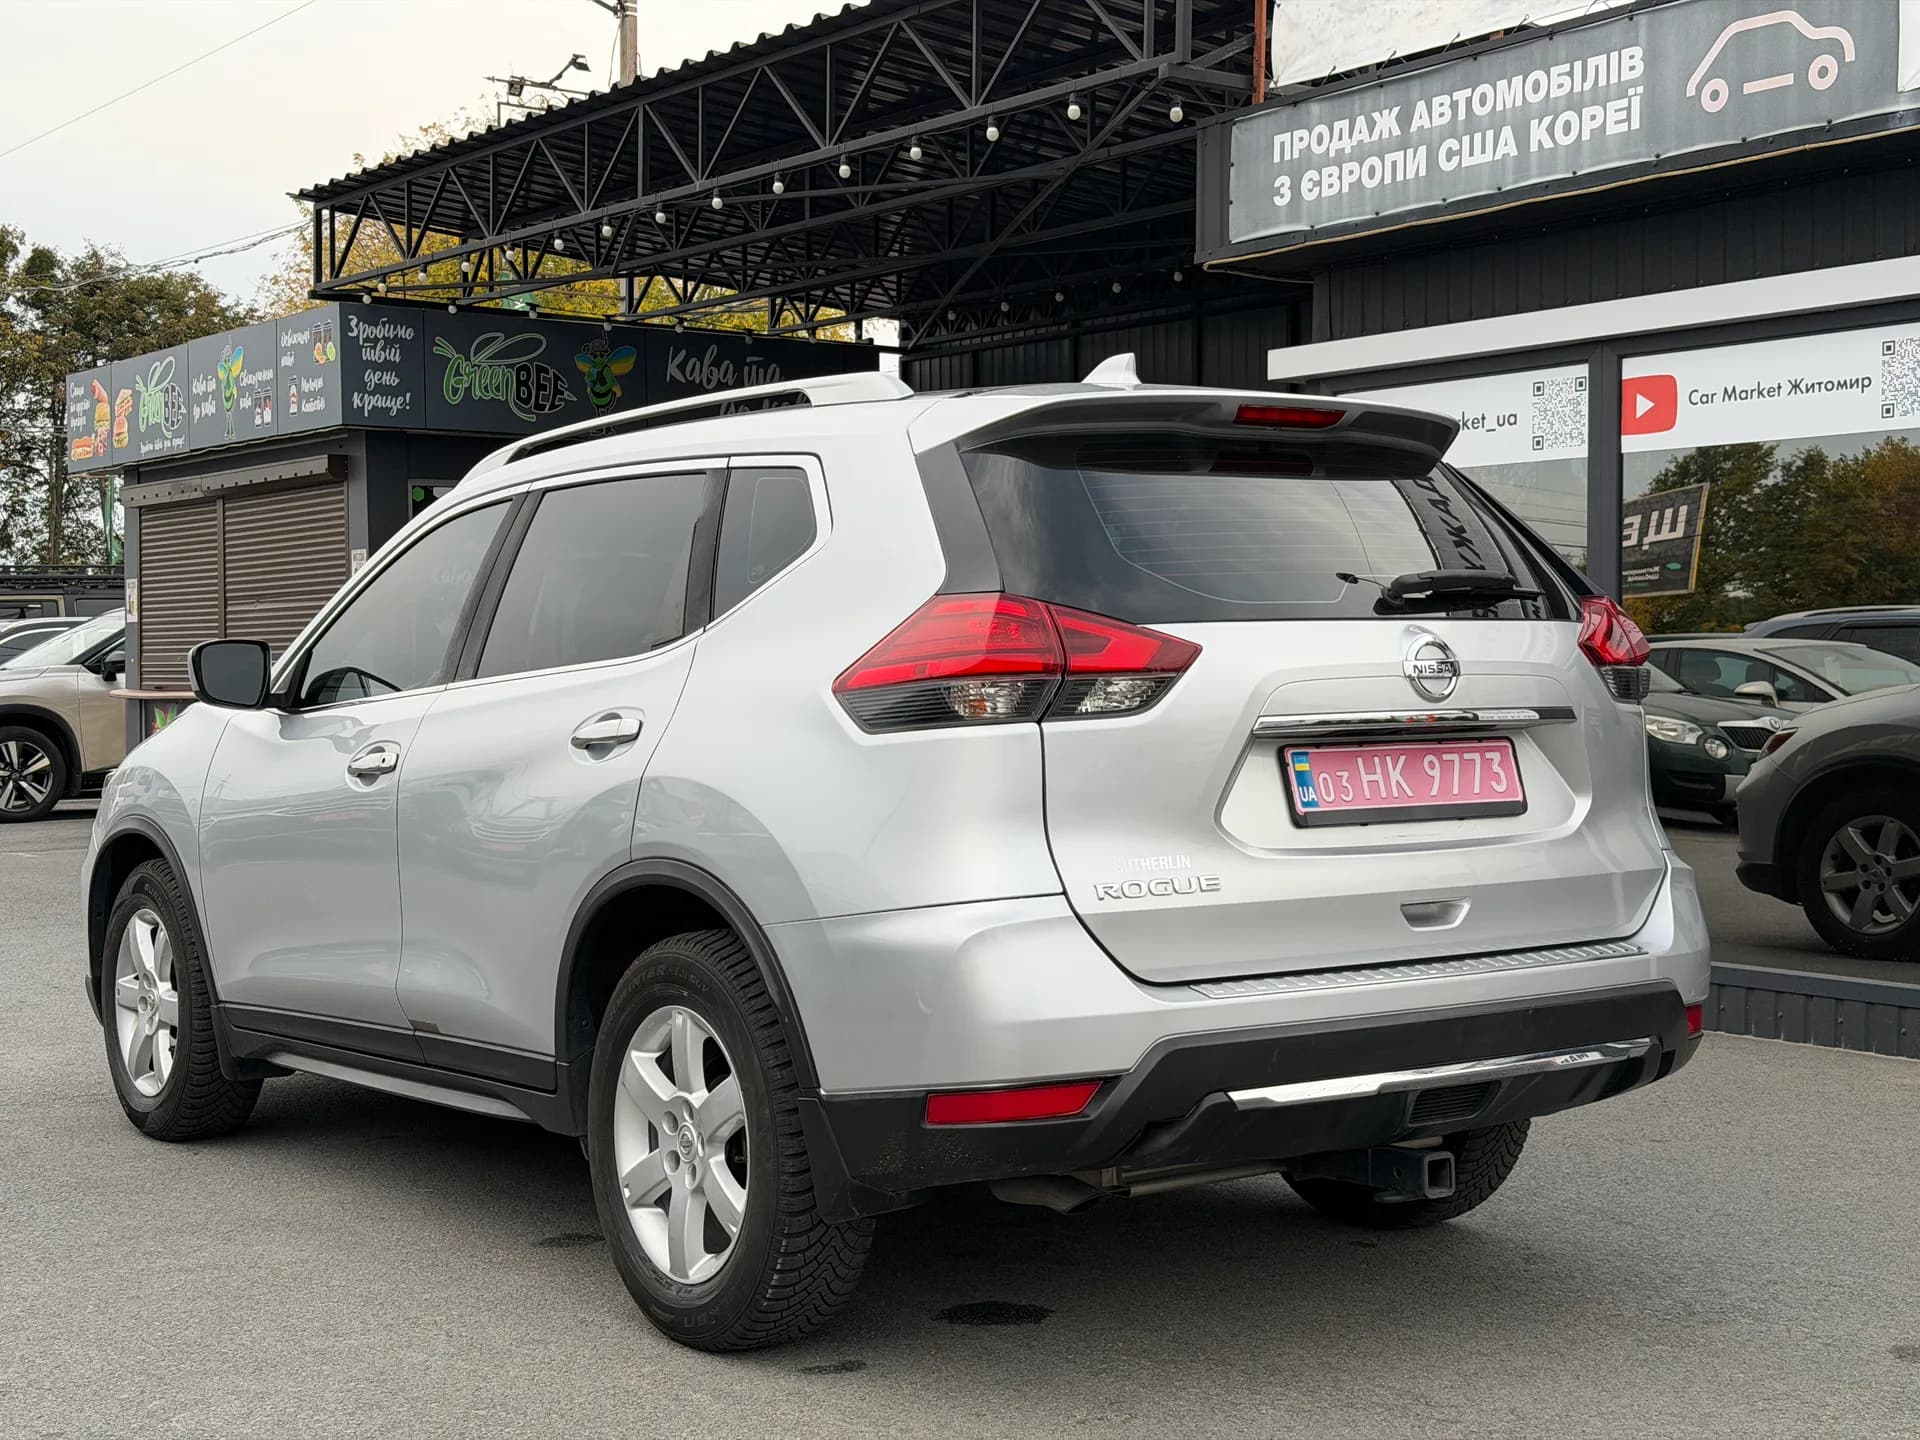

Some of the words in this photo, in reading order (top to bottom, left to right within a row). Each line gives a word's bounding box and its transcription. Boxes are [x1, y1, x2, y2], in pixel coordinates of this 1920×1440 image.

[1273, 106, 1401, 163] ПРОДАЖ
[1410, 46, 1644, 133] АВТОМОБІЛІВ
[1273, 176, 1292, 207] З
[1300, 145, 1427, 201] ЄВРОПИ
[1438, 126, 1518, 172] США
[1529, 85, 1644, 152] КОРЕЇ
[347, 315, 415, 345] Зробимо
[361, 340, 401, 363] твій
[364, 369, 400, 391] день
[666, 344, 738, 389] Кава
[351, 391, 411, 417] краще!
[1688, 388, 1717, 407] Car
[1722, 381, 1782, 403] Market
[1787, 374, 1872, 397] Житомир
[1458, 411, 1517, 432] ket_ua
[1318, 771, 1353, 802] 03
[1357, 755, 1414, 799] HK
[1423, 752, 1508, 796] 9773
[1300, 786, 1317, 801] UA
[1094, 874, 1221, 901] ROGUE
